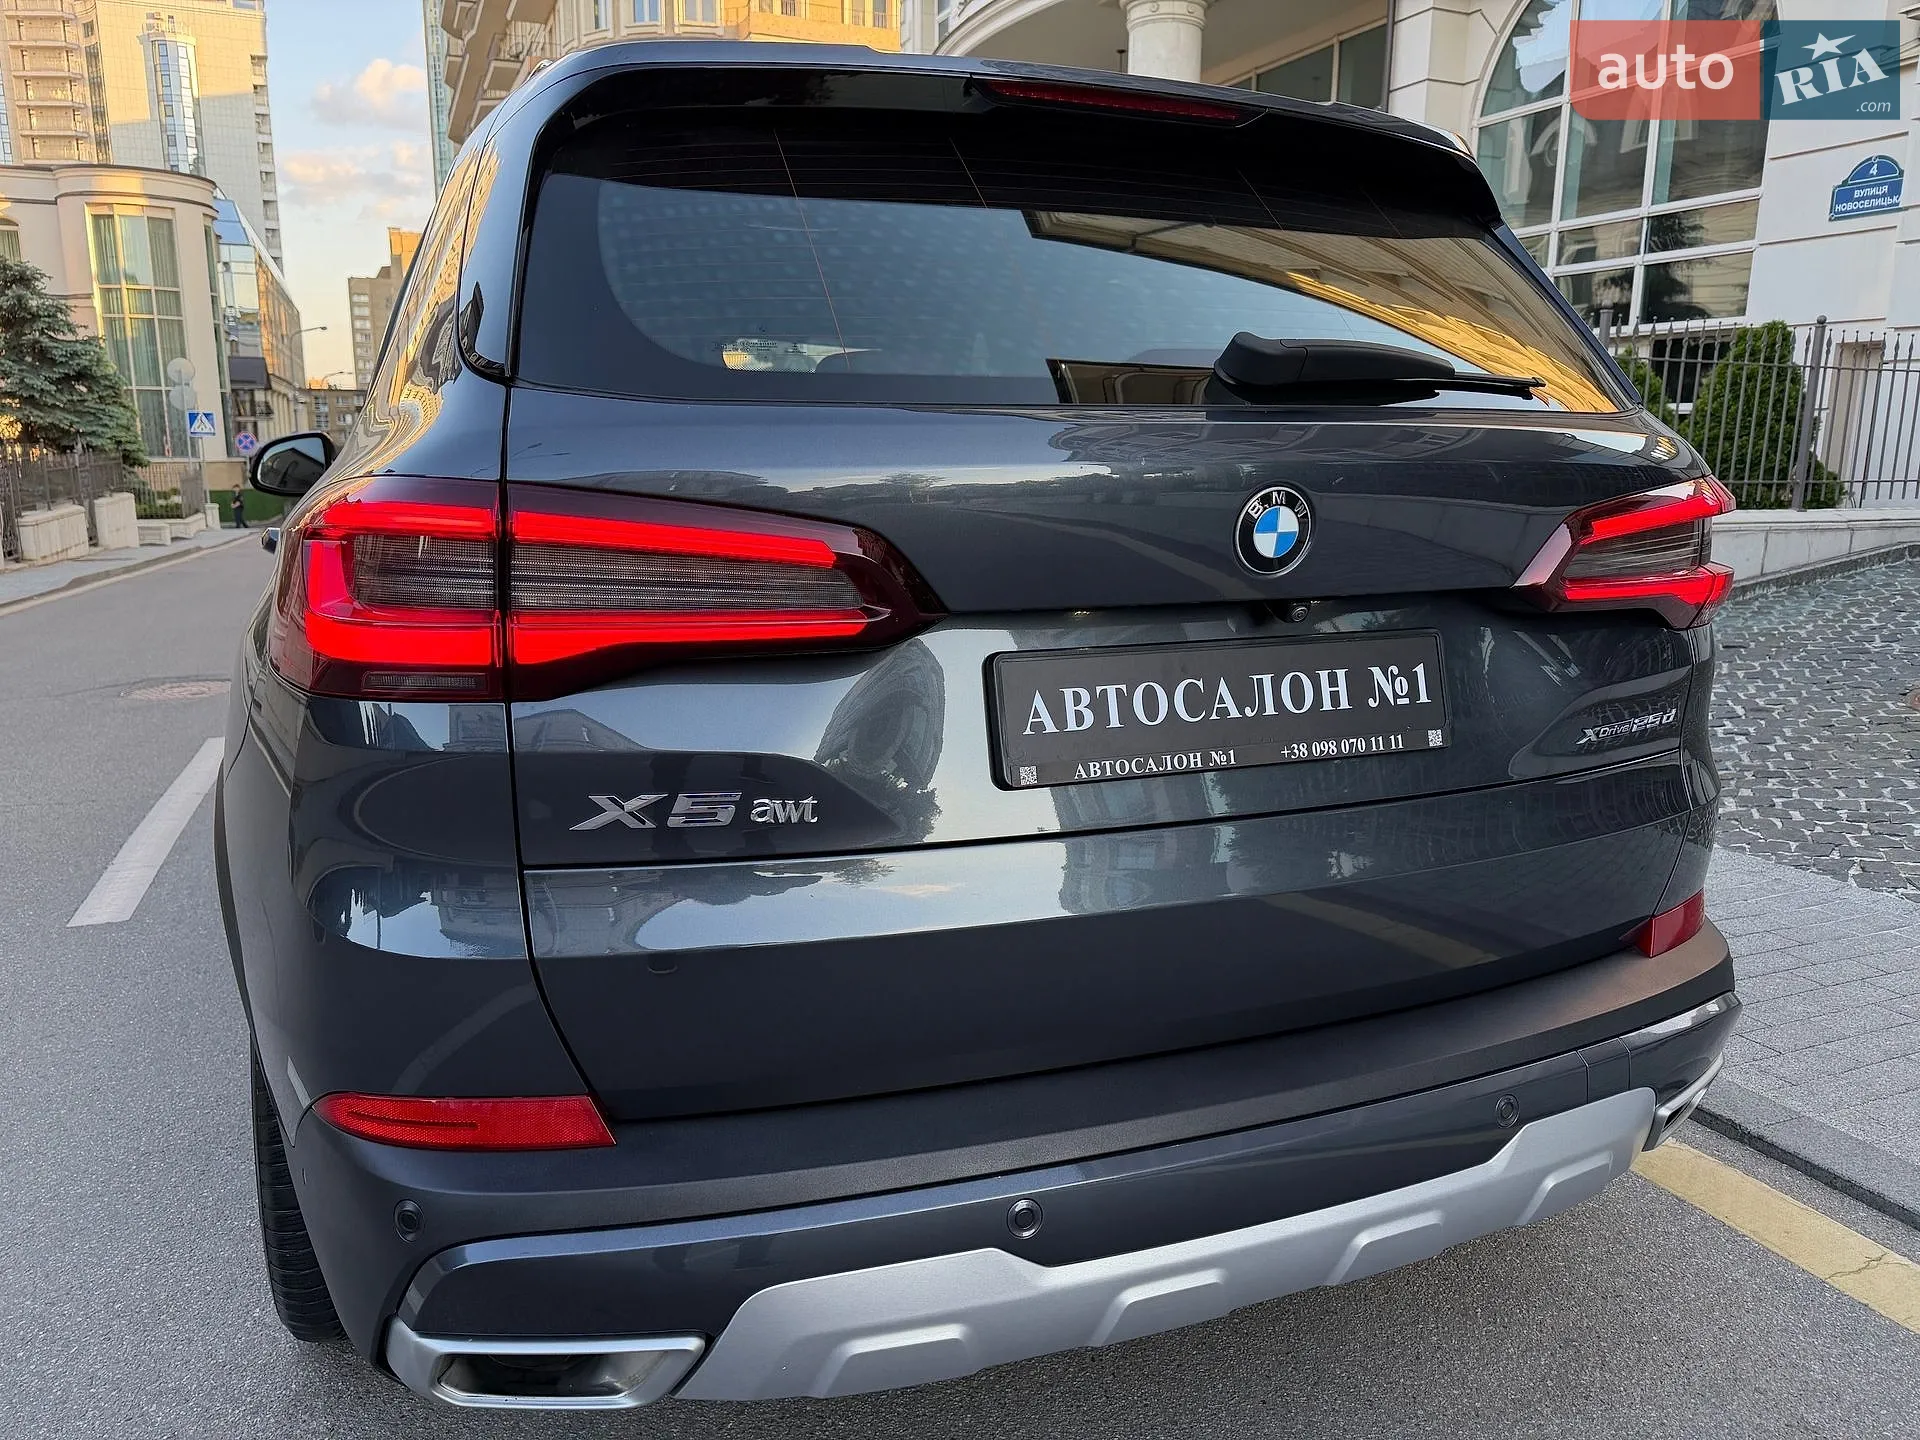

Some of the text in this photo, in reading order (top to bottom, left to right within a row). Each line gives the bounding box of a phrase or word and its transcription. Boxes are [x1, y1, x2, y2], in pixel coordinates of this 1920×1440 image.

[1869, 163, 1878, 176] 4
[1854, 185, 1889, 198] ВУЛИЦЯ
[1248, 491, 1307, 519] BMW
[1022, 662, 1432, 735] АВТОСАЛОН №1
[1280, 733, 1404, 760] +38 098 070 11 11
[1074, 749, 1237, 780] АВТОСАЛОН №1
[569, 792, 819, 831] X5 awt
